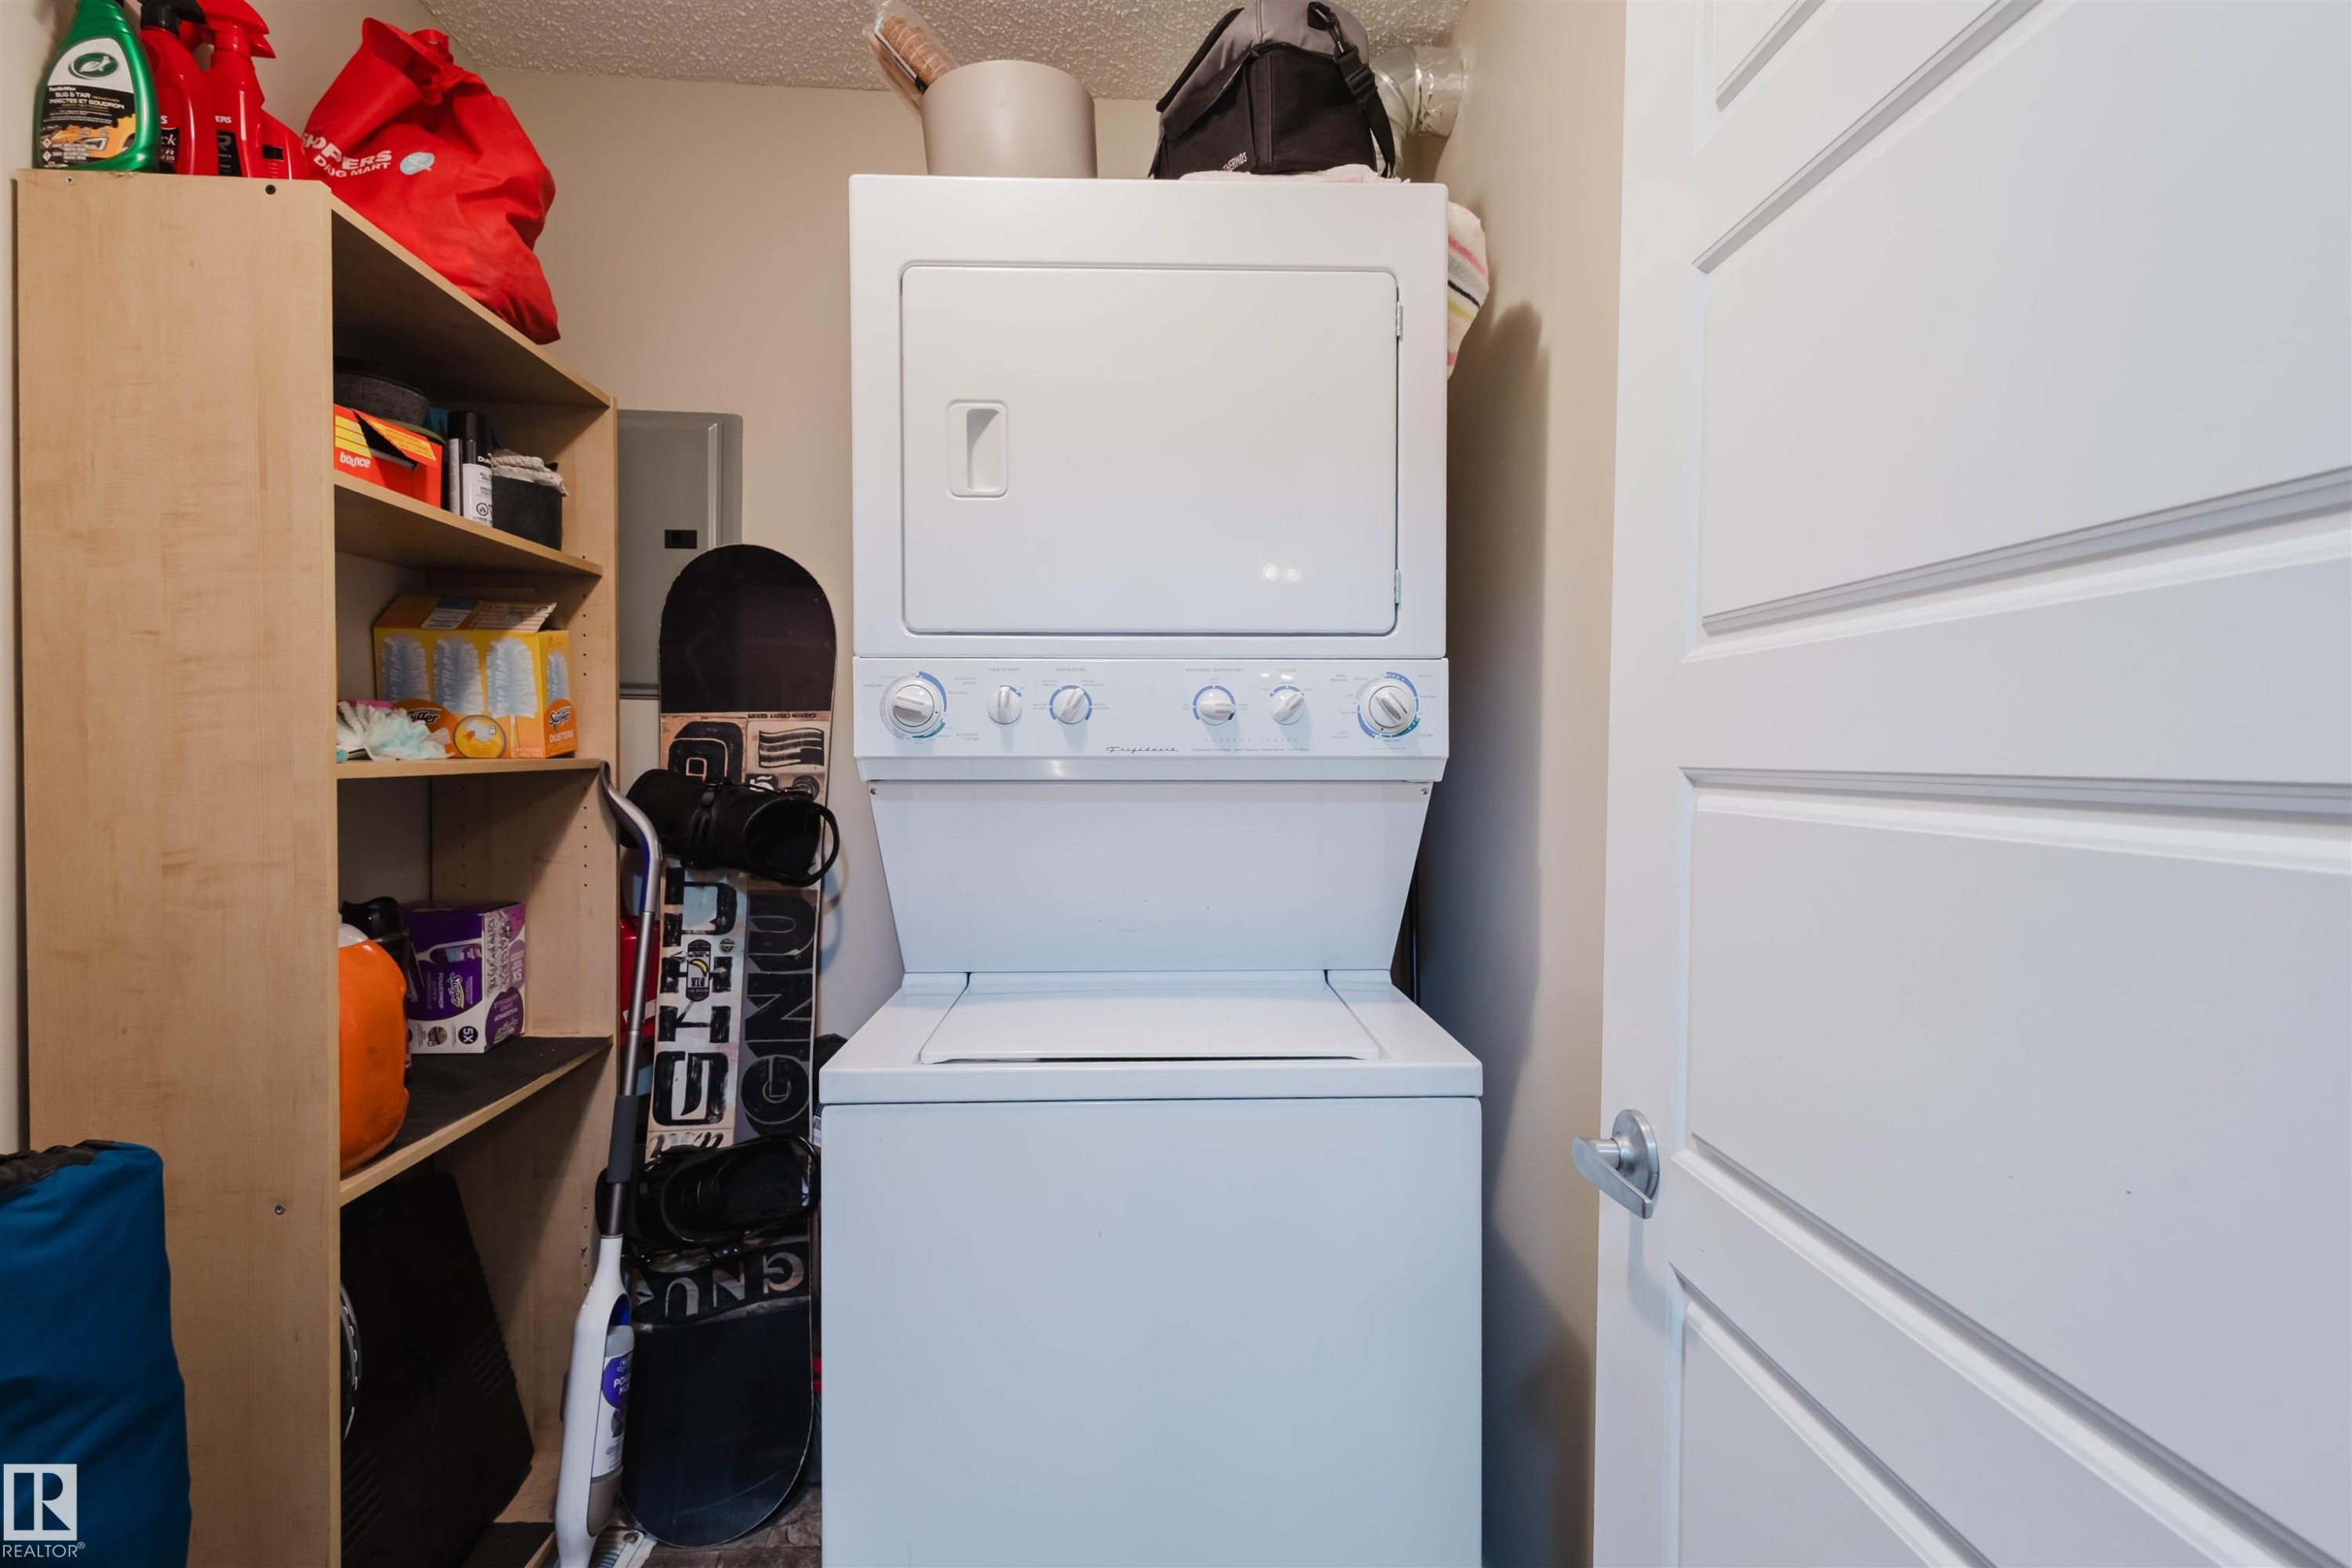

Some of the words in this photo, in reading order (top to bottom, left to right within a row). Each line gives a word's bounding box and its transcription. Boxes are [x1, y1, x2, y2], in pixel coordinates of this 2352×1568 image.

[88, 100, 125, 110] GOUDRON
[350, 162, 391, 176] MART
[339, 452, 372, 468] bounce
[409, 710, 439, 724] iffer
[549, 729, 575, 743] DUSTERS
[1105, 746, 1179, 755] Frigidaire
[448, 971, 463, 1007] Swiffer
[741, 891, 817, 1126] GNU
[463, 1027, 474, 1044] 5X
[664, 1250, 805, 1319] GNU
